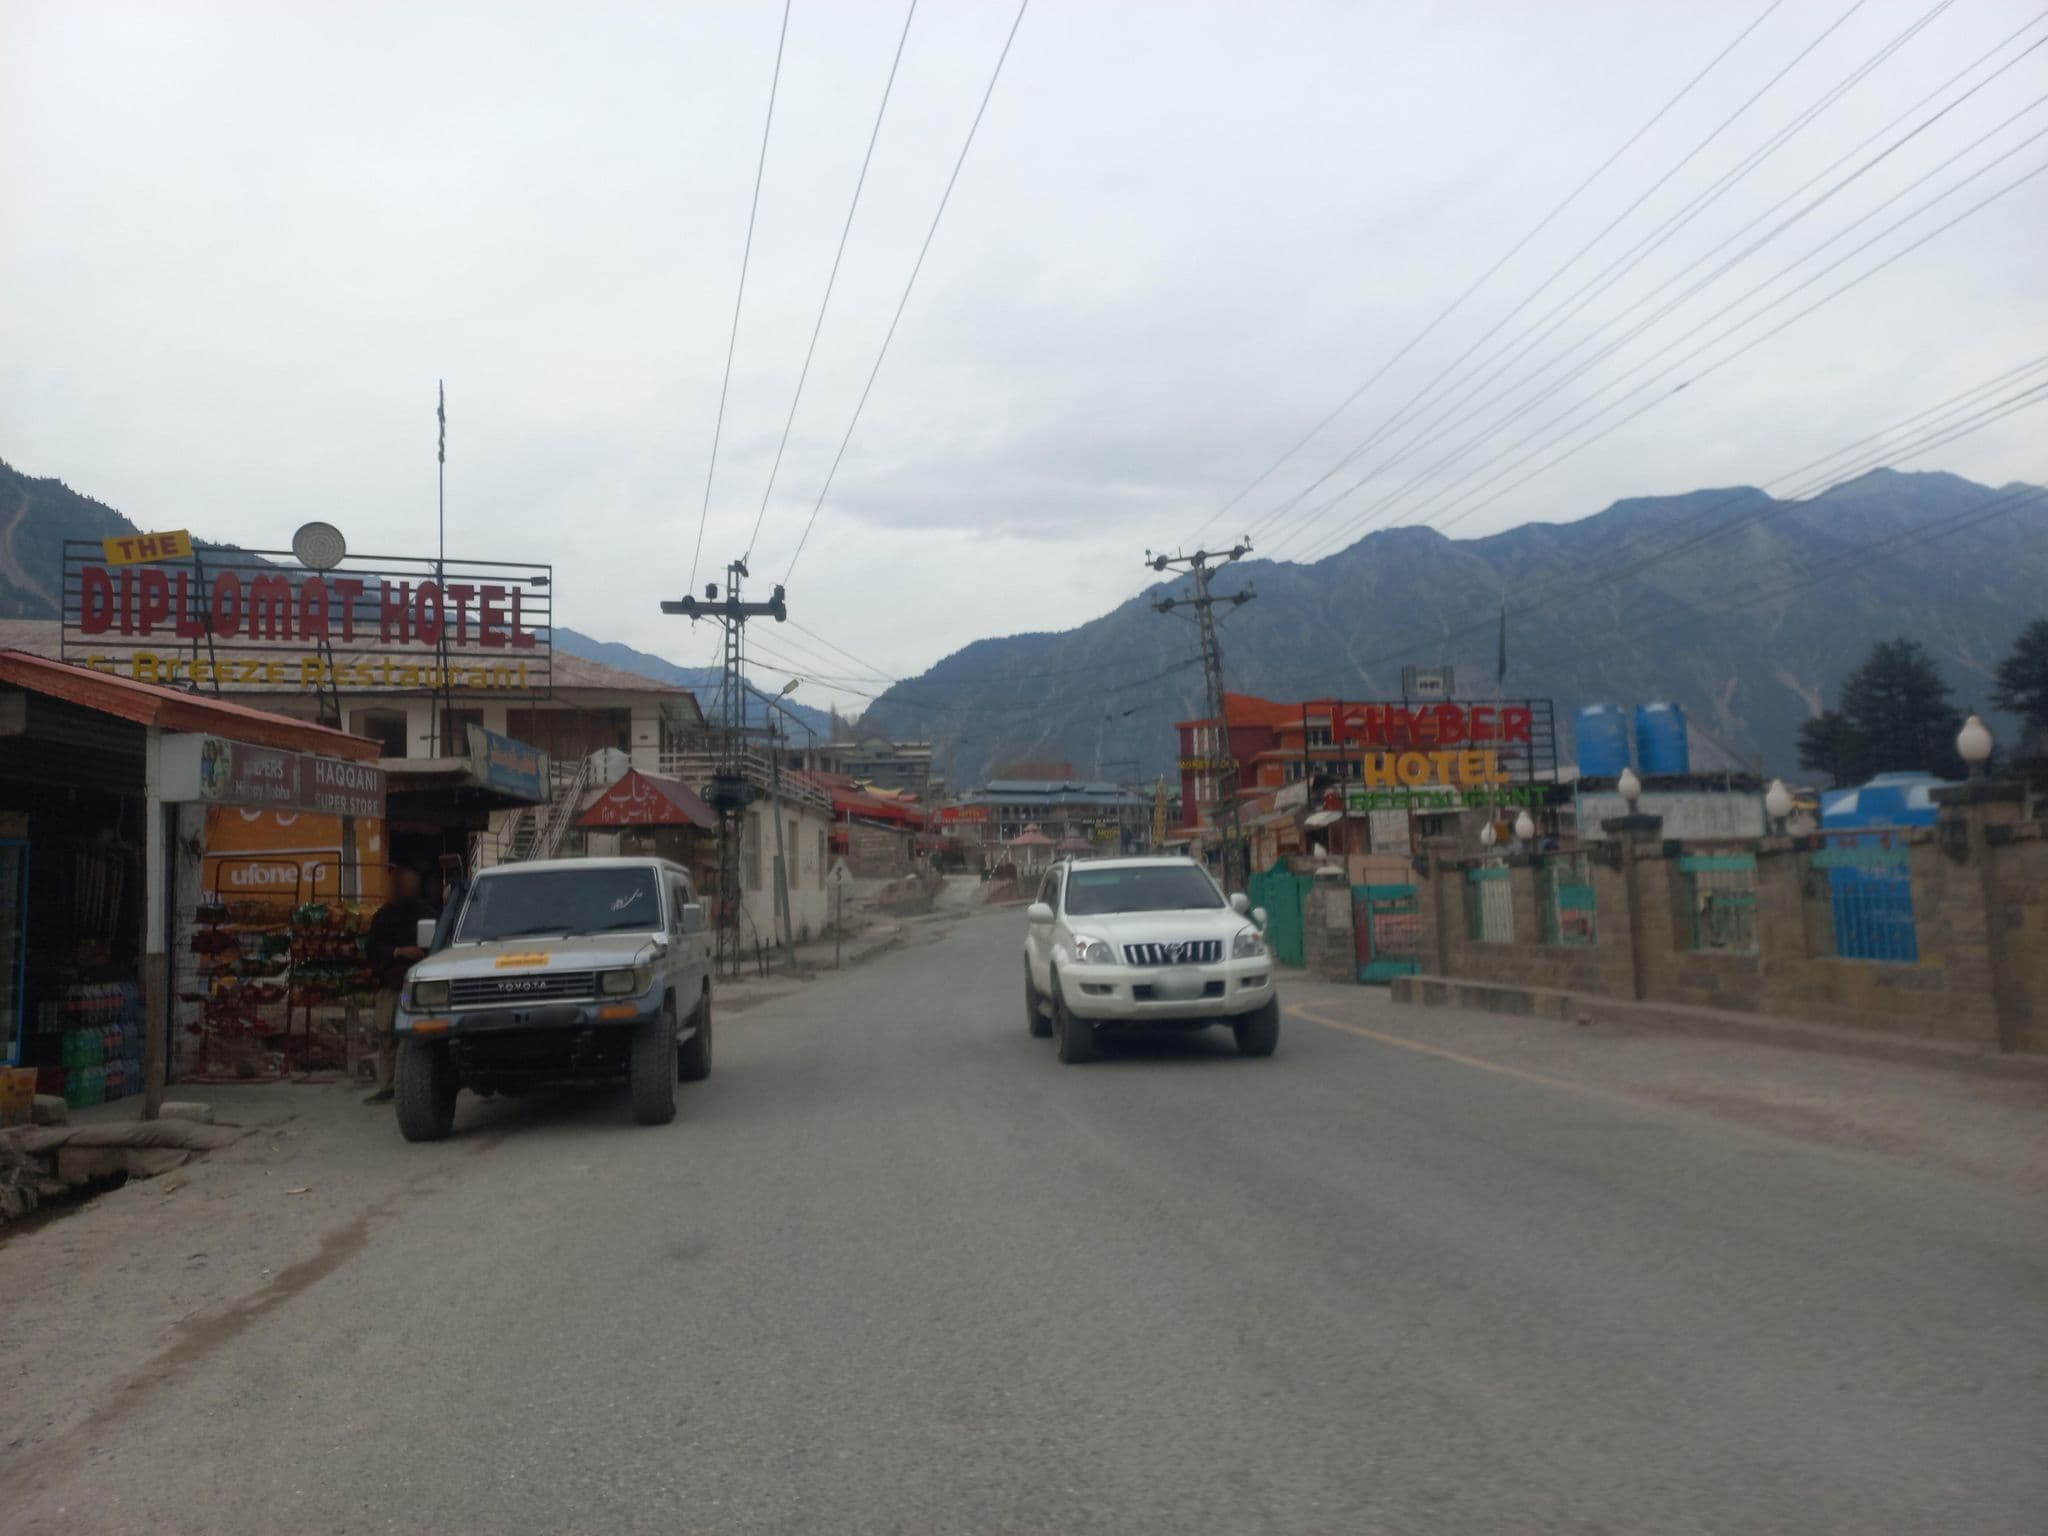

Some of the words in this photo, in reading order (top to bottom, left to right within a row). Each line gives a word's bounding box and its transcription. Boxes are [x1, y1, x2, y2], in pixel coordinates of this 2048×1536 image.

[117, 534, 179, 560] THE
[81, 566, 365, 642] DIPLOMAT
[380, 579, 535, 649] HOTEL
[1330, 703, 1533, 746] KHYBER
[315, 760, 377, 792] HAQQANI
[1364, 751, 1509, 786] HOTEL
[315, 792, 346, 811] SUPER
[231, 863, 297, 885] ufone
[498, 981, 546, 993] TOYOTA
